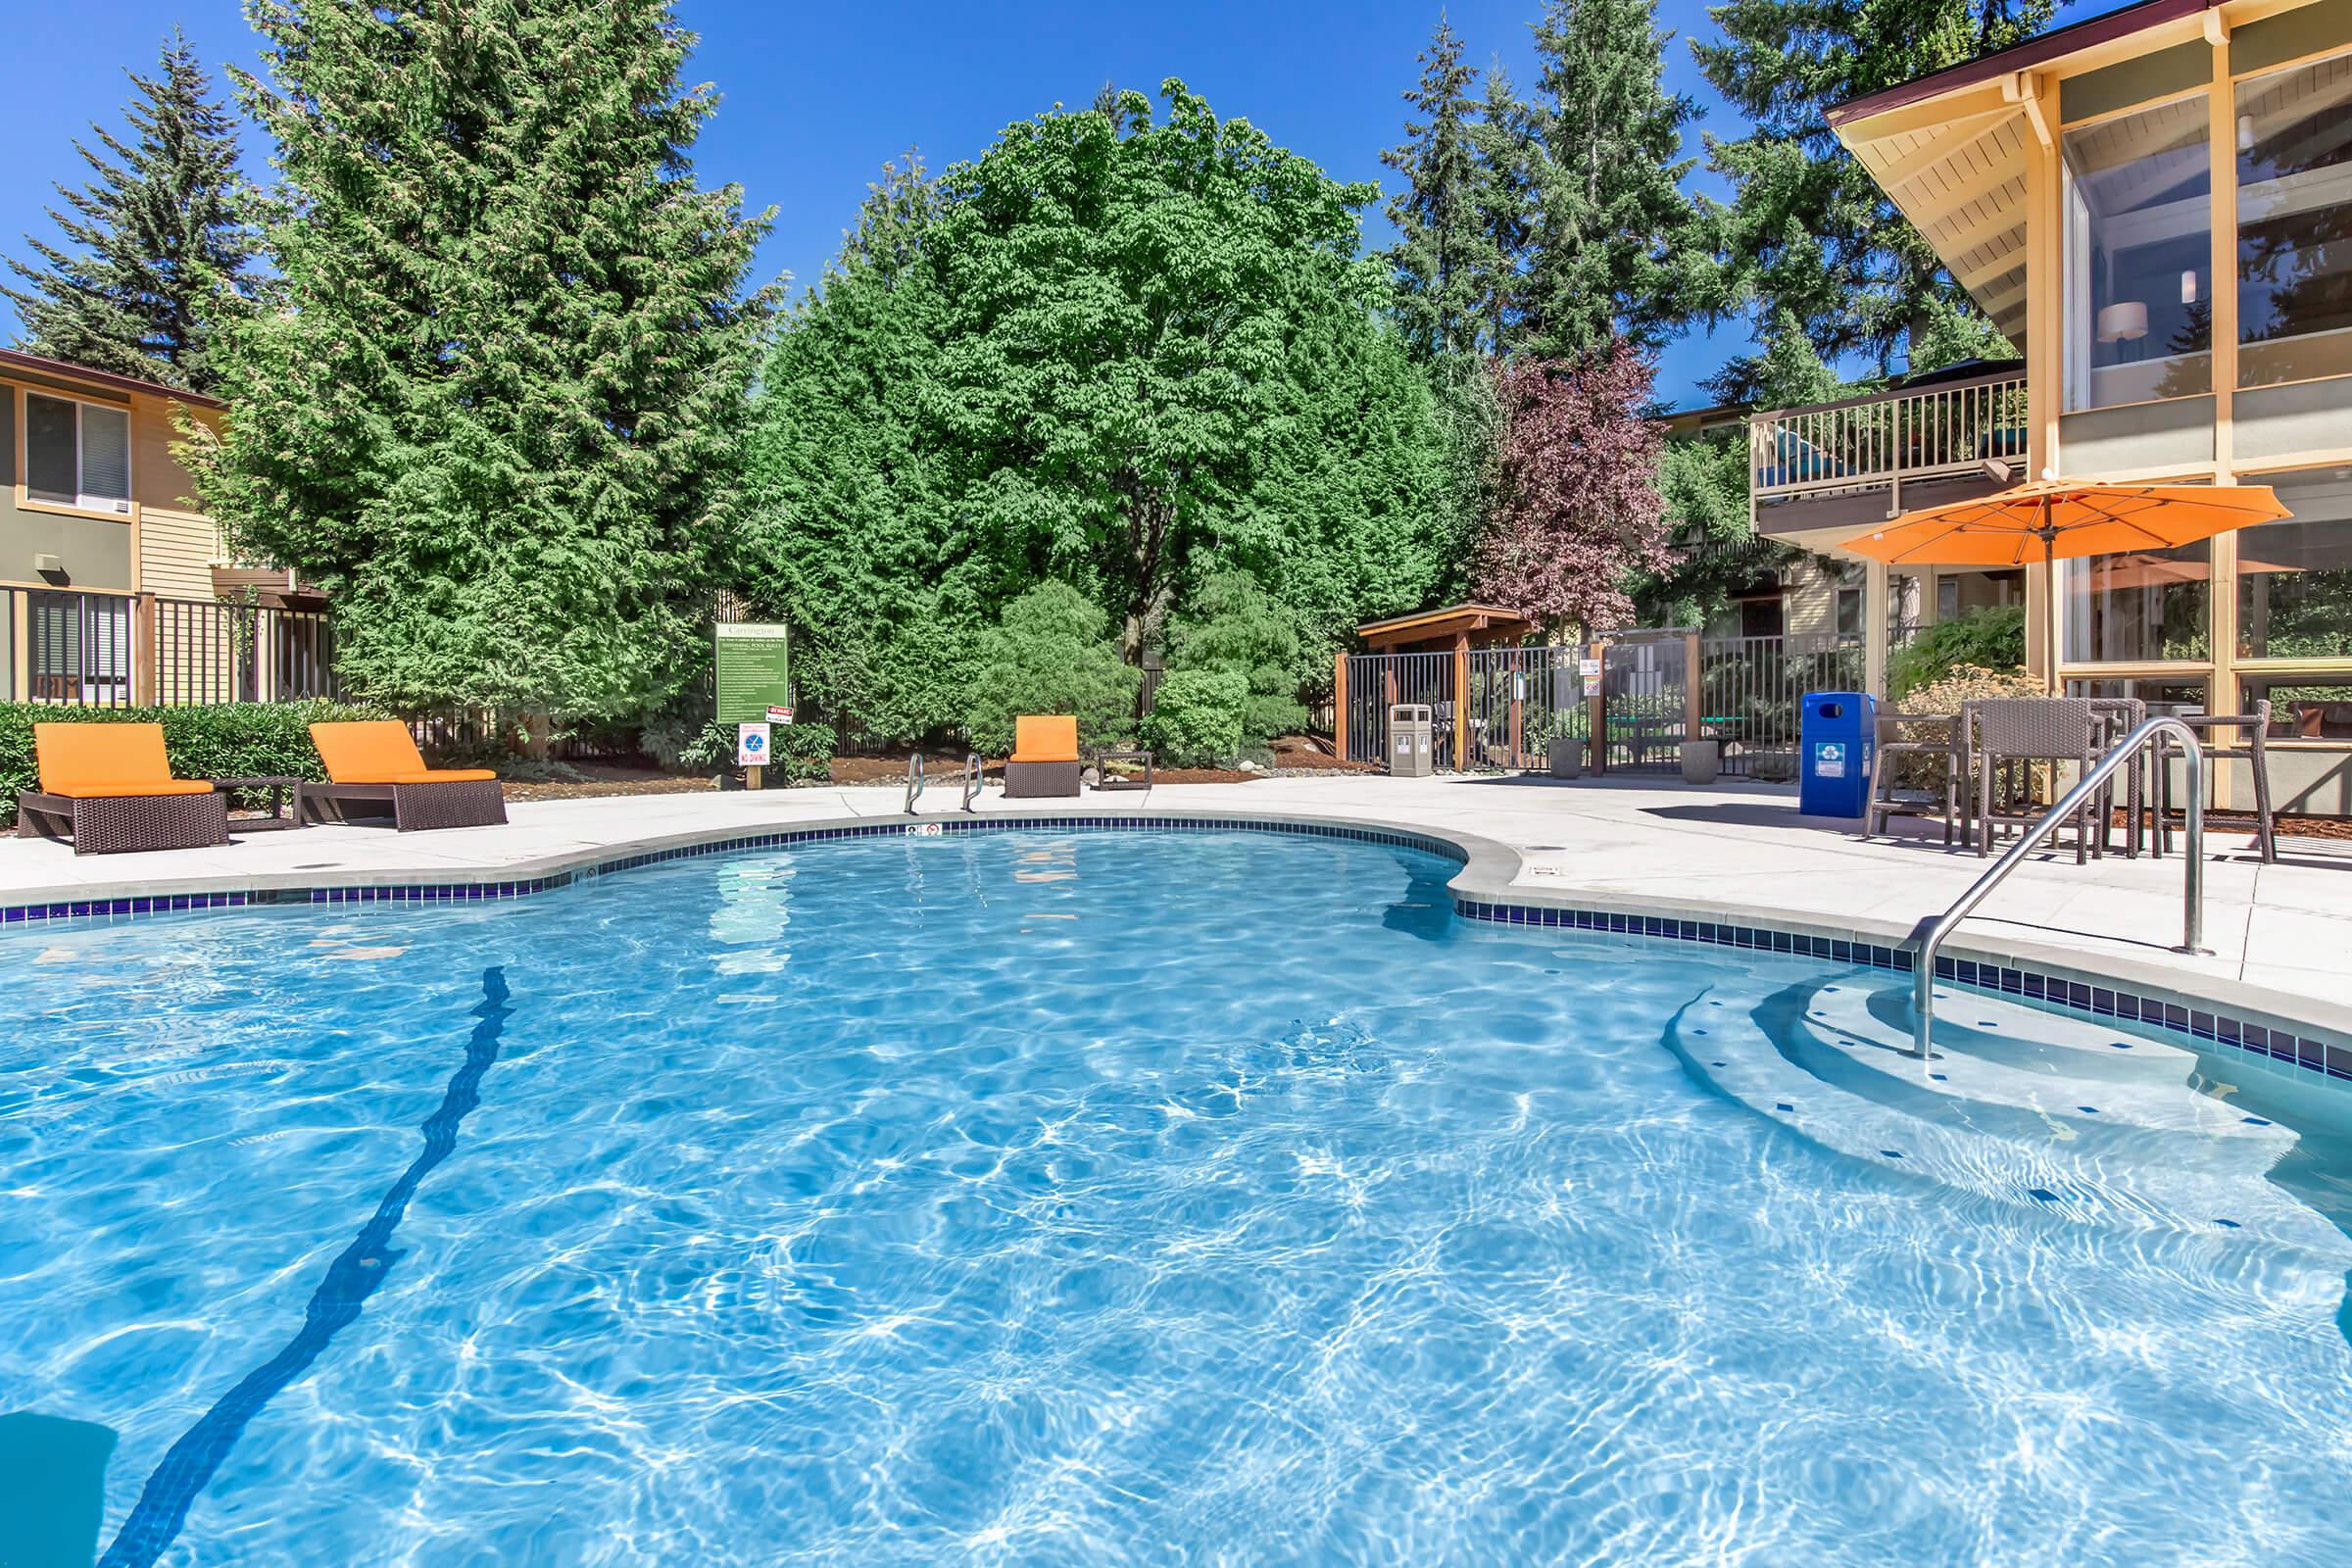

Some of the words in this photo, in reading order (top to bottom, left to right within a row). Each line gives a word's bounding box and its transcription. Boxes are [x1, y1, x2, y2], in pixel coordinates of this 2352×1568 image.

[729, 626, 775, 636] Carrington
[741, 754, 748, 762] NO
[750, 754, 766, 762] DIVING
